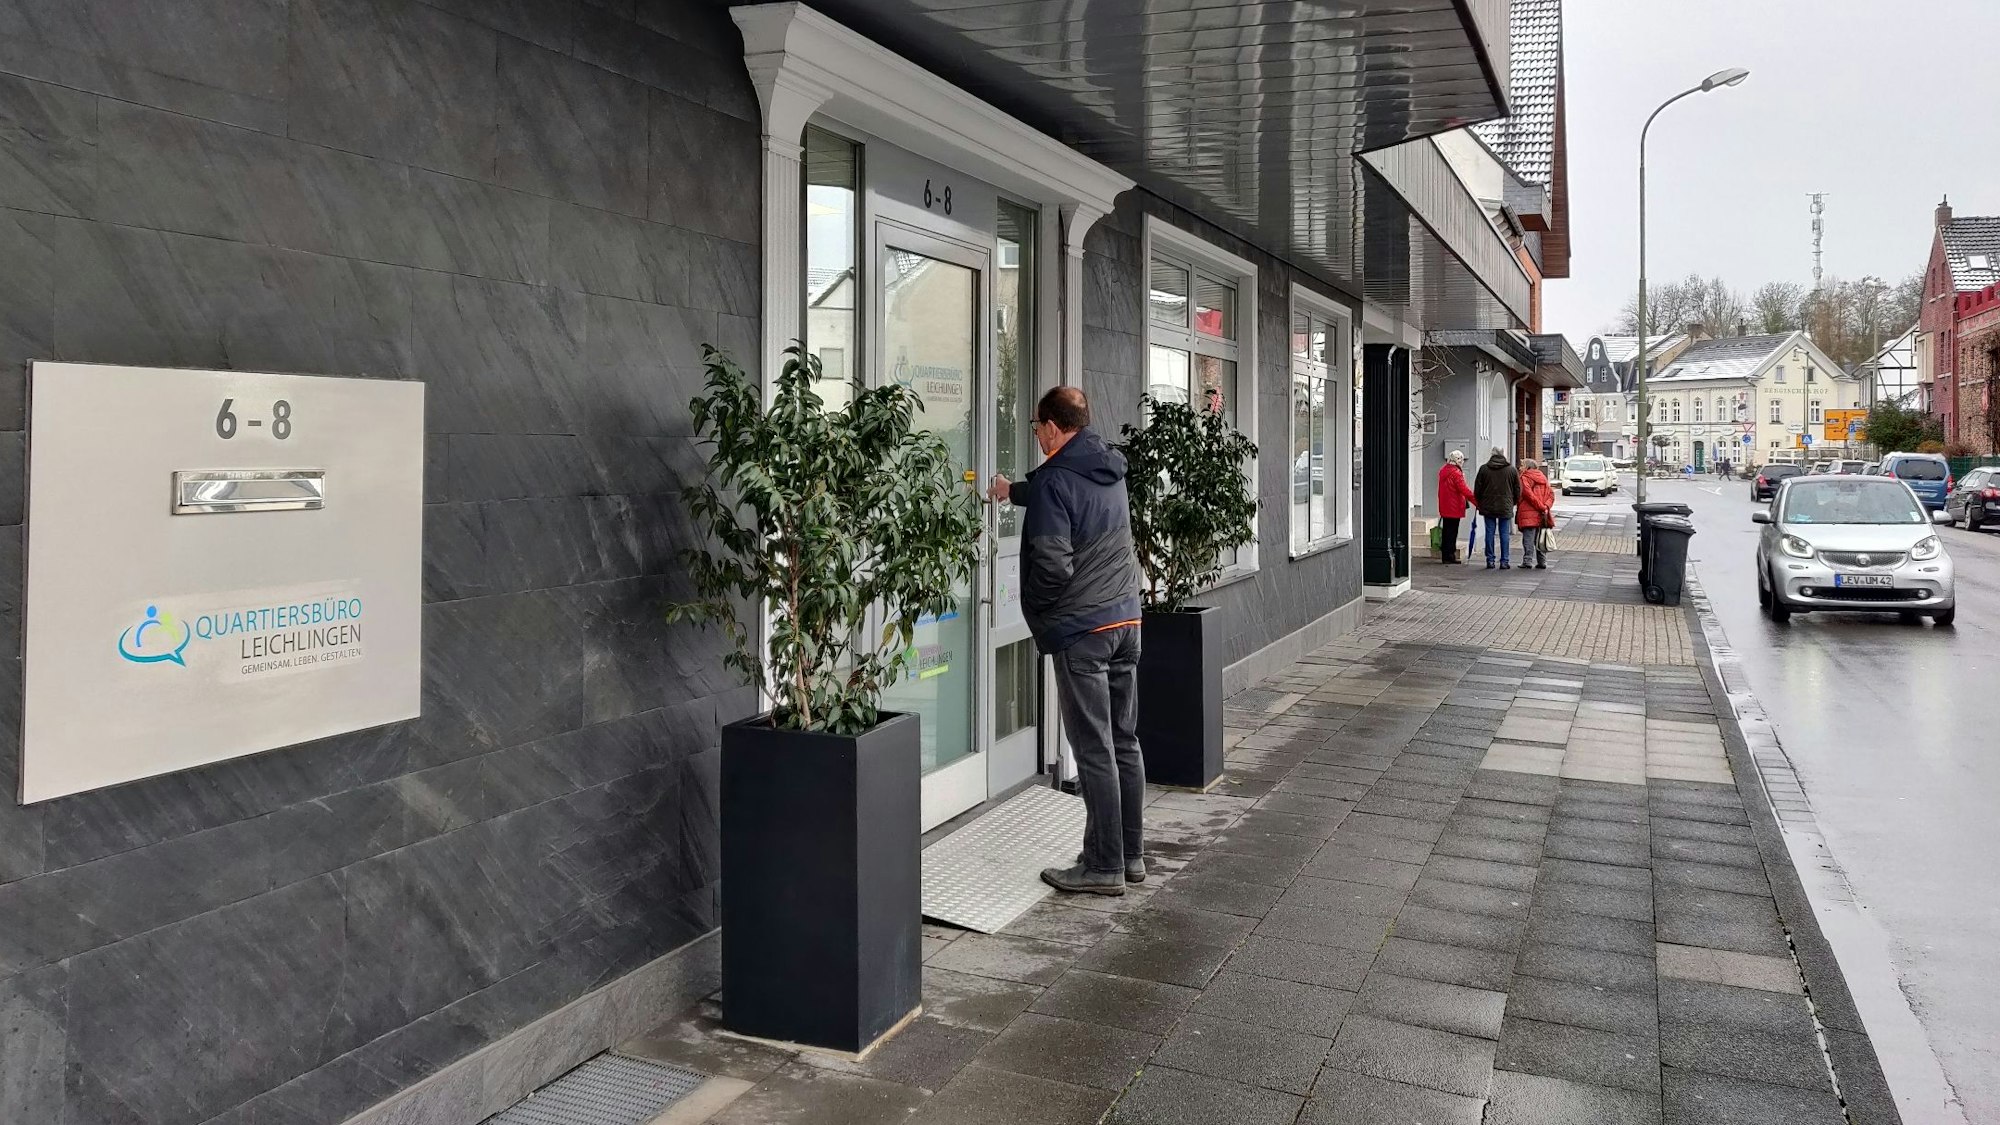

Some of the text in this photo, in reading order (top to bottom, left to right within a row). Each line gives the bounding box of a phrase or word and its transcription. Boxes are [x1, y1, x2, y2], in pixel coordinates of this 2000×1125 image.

[1841, 576, 1860, 585] LEV
[1880, 576, 1892, 586] 42
[196, 597, 362, 640] QUARTIERSBÜRO
[241, 624, 361, 659] LEICHLINGEN
[241, 658, 292, 675] GEMEINSAM.
[293, 655, 320, 667] LEBEN.
